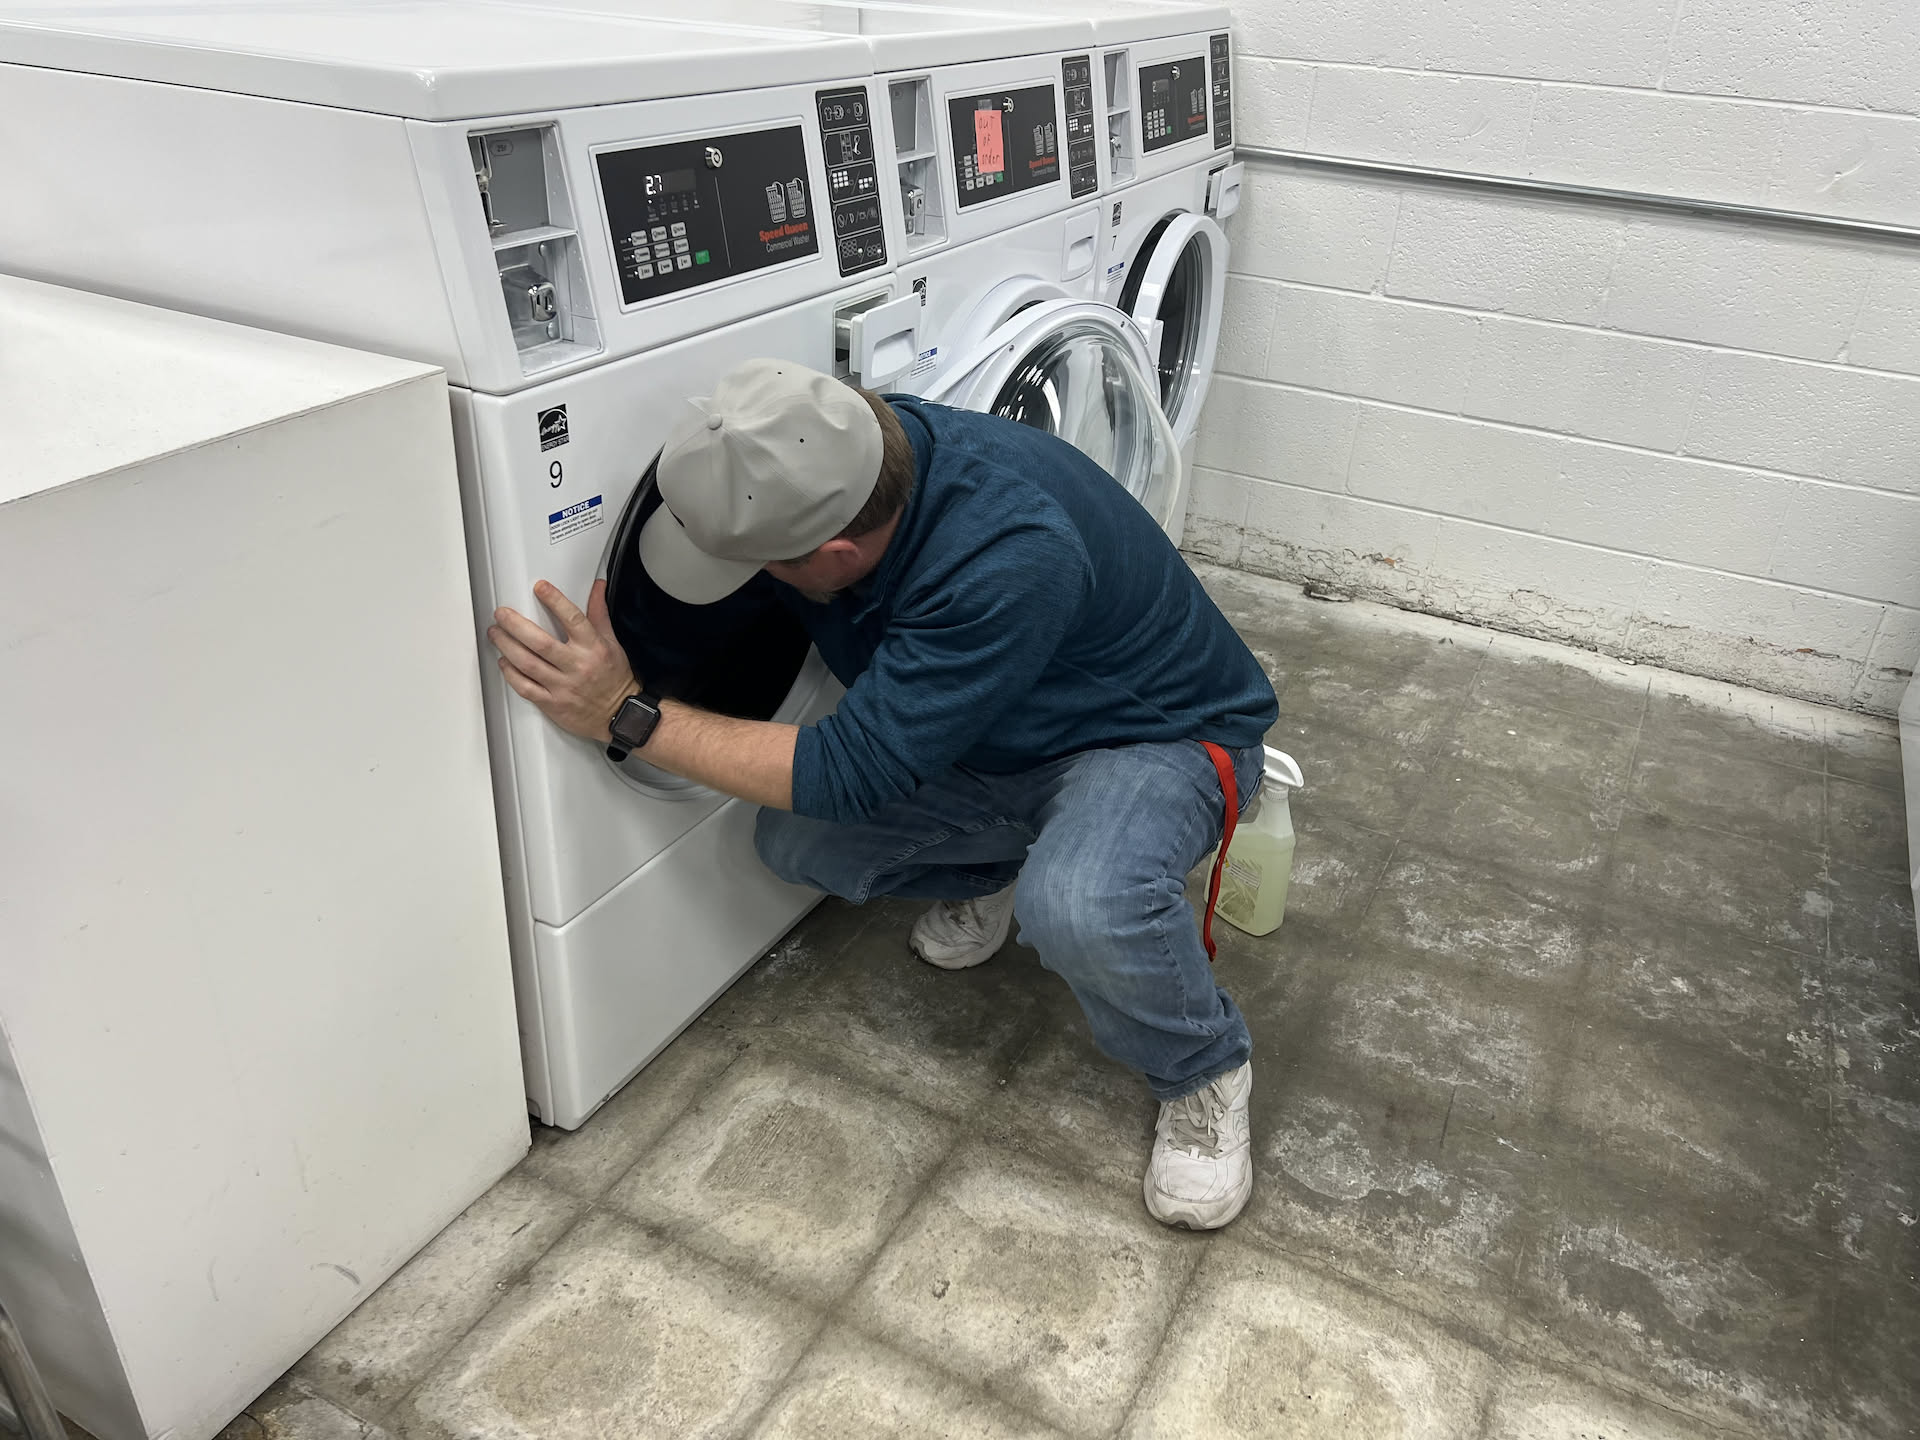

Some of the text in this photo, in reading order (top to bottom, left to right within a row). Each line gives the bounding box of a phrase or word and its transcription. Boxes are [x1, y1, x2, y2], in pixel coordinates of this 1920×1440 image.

[981, 148, 1000, 165] order
[759, 222, 809, 243] Speed Queen
[1111, 235, 1118, 252] 7
[549, 460, 563, 489] 9
[562, 500, 591, 519] NOTICE
